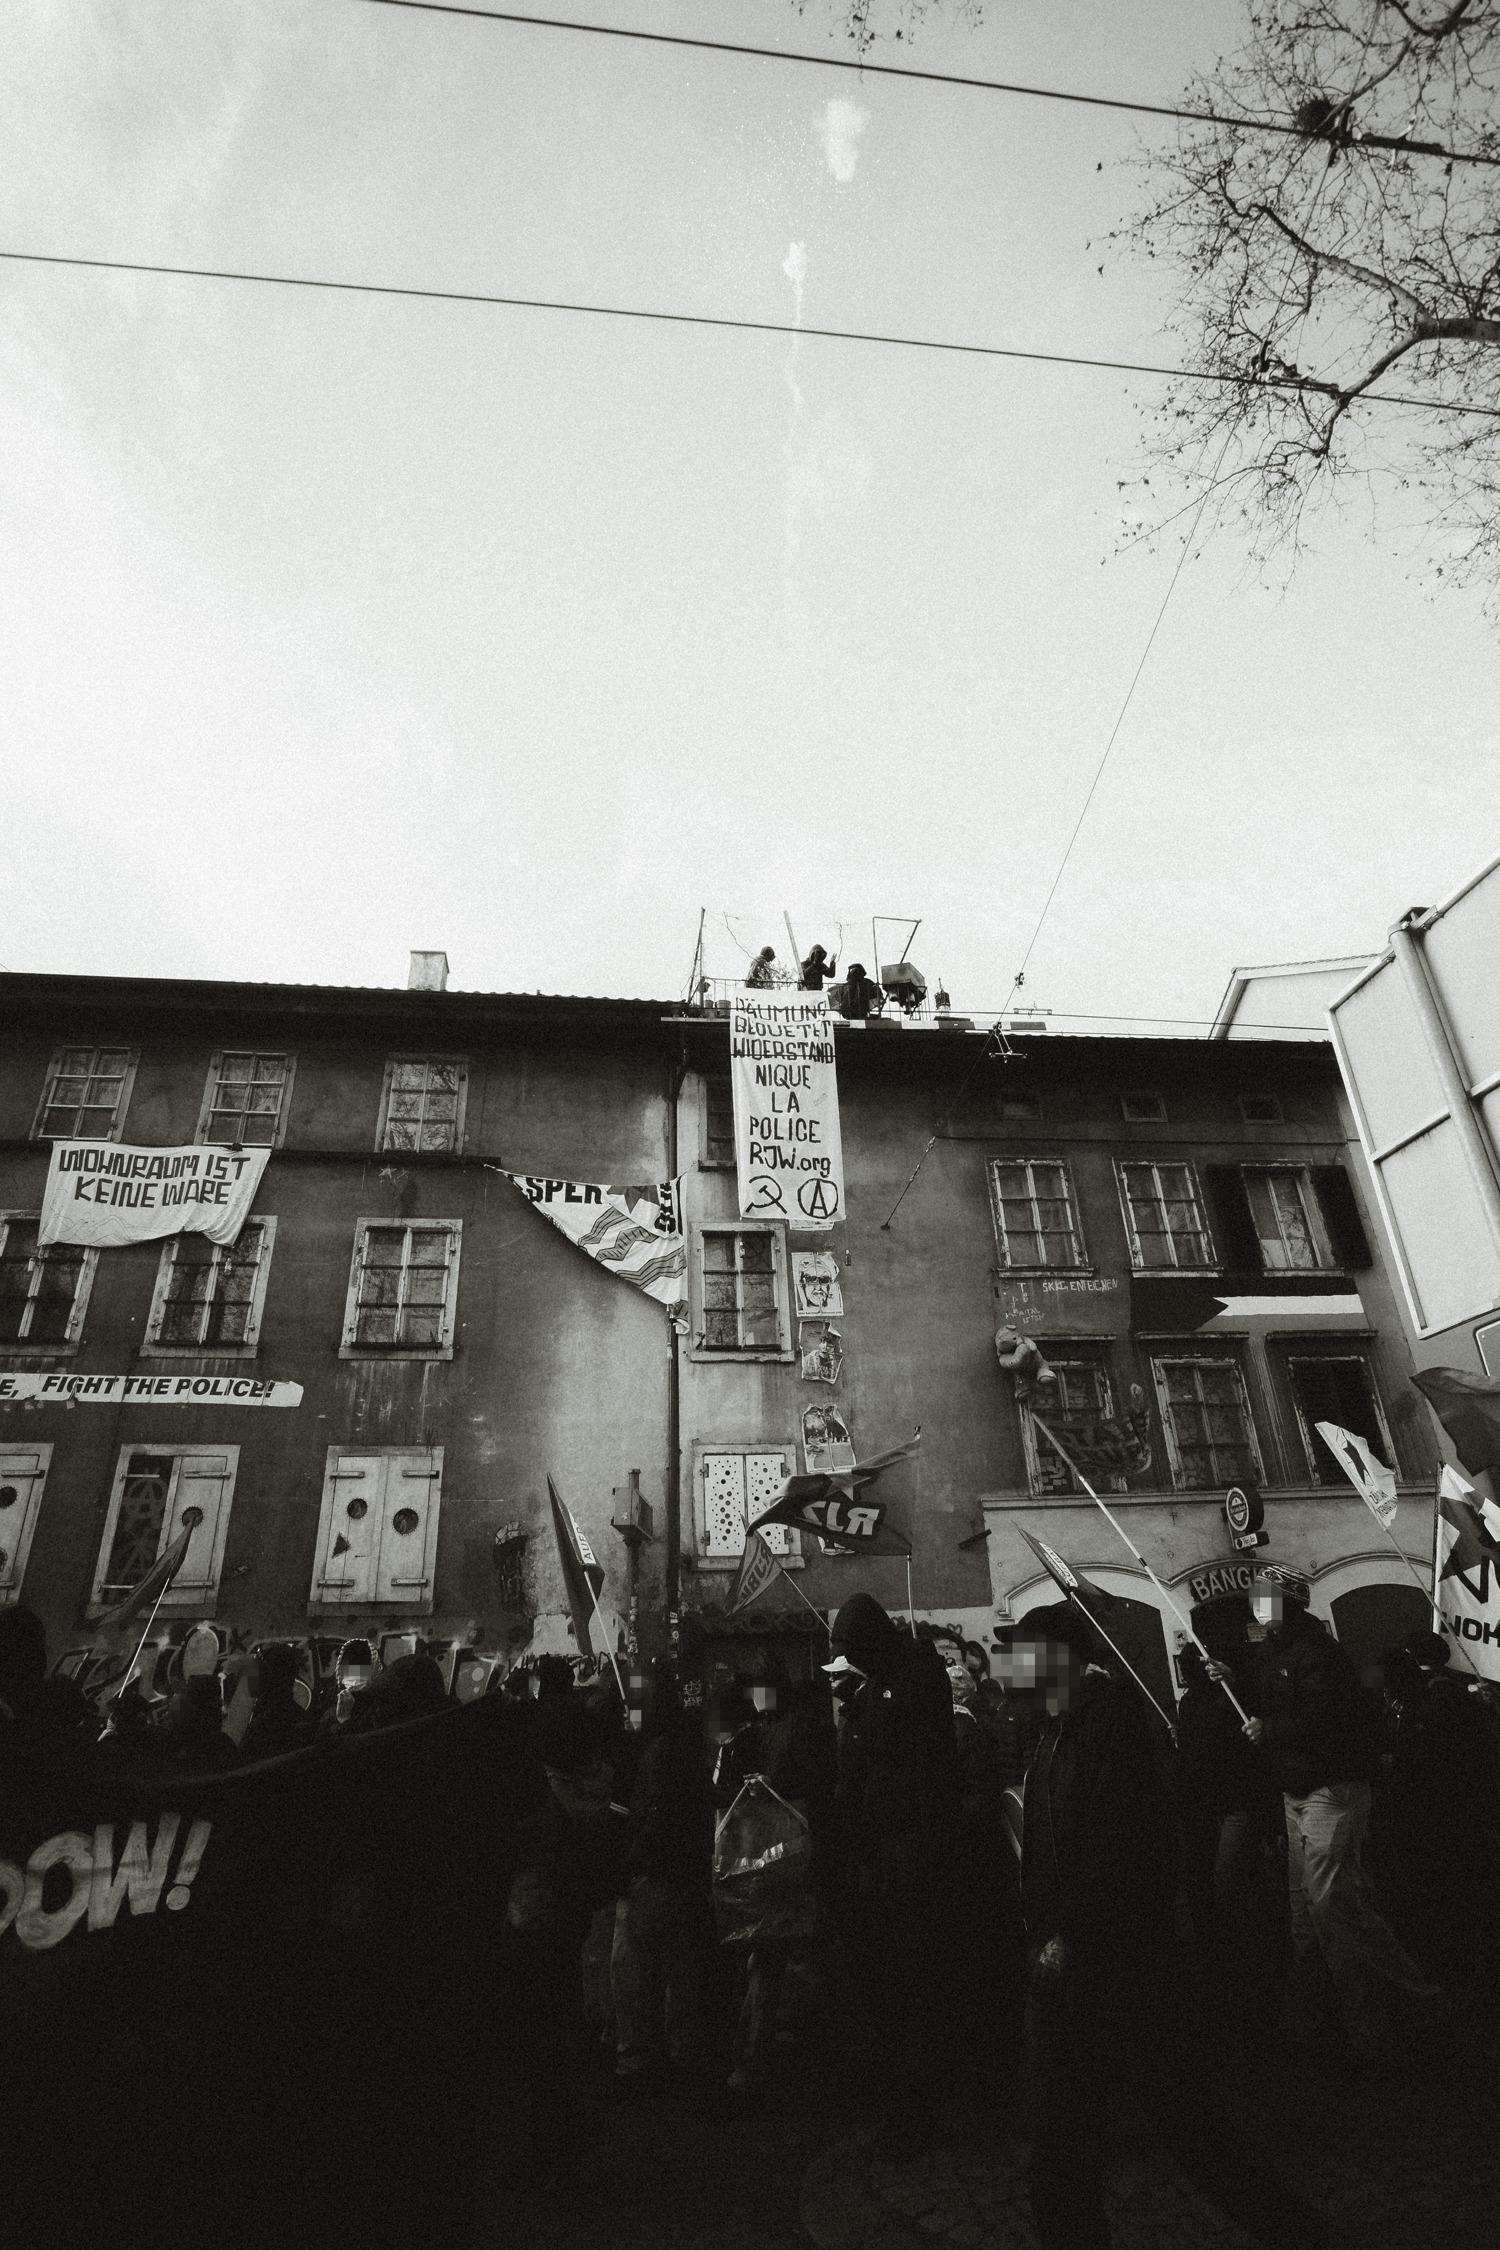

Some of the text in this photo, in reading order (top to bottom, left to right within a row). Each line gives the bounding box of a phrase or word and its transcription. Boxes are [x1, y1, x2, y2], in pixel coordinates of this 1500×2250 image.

[733, 1037, 833, 1063] WIDERSTAND
[756, 1064, 810, 1089] NIQUE
[772, 1091, 799, 1113] LA
[749, 1115, 820, 1143] POLICE
[59, 1149, 250, 1180] WOHNRAUM IST
[74, 1176, 232, 1208] KEINE WARE
[41, 1375, 118, 1395] FIGHT
[124, 1376, 171, 1396] THE
[175, 1377, 276, 1398] POLICE!
